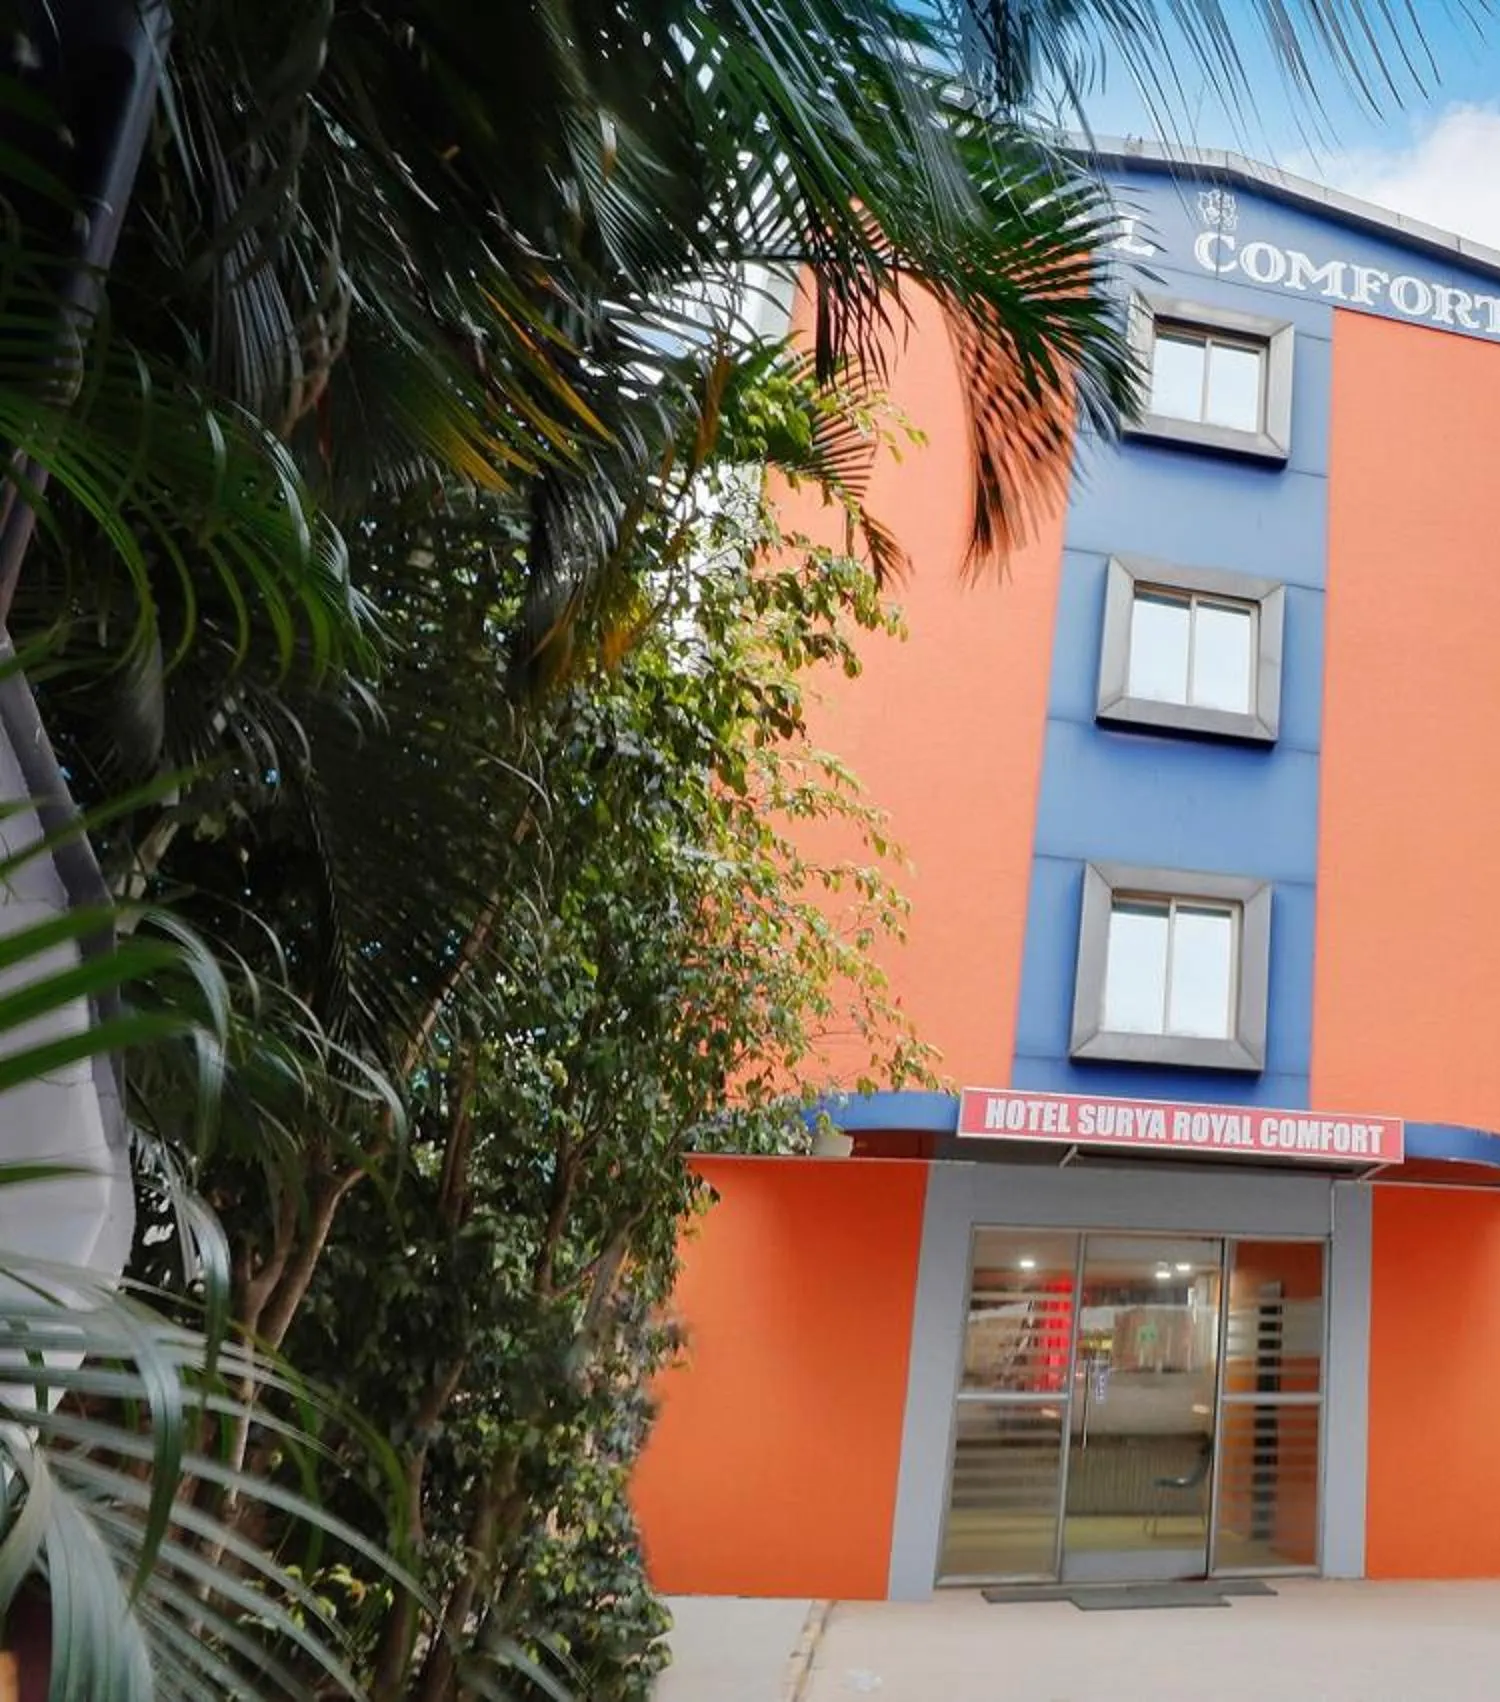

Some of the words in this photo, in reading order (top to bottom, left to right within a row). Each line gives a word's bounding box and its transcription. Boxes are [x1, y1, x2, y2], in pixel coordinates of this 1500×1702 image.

[985, 1097, 1070, 1134] HOTEL
[1077, 1104, 1167, 1140] SURYA
[1172, 1111, 1255, 1146] ROYAL
[1259, 1118, 1385, 1154] COMFORT
